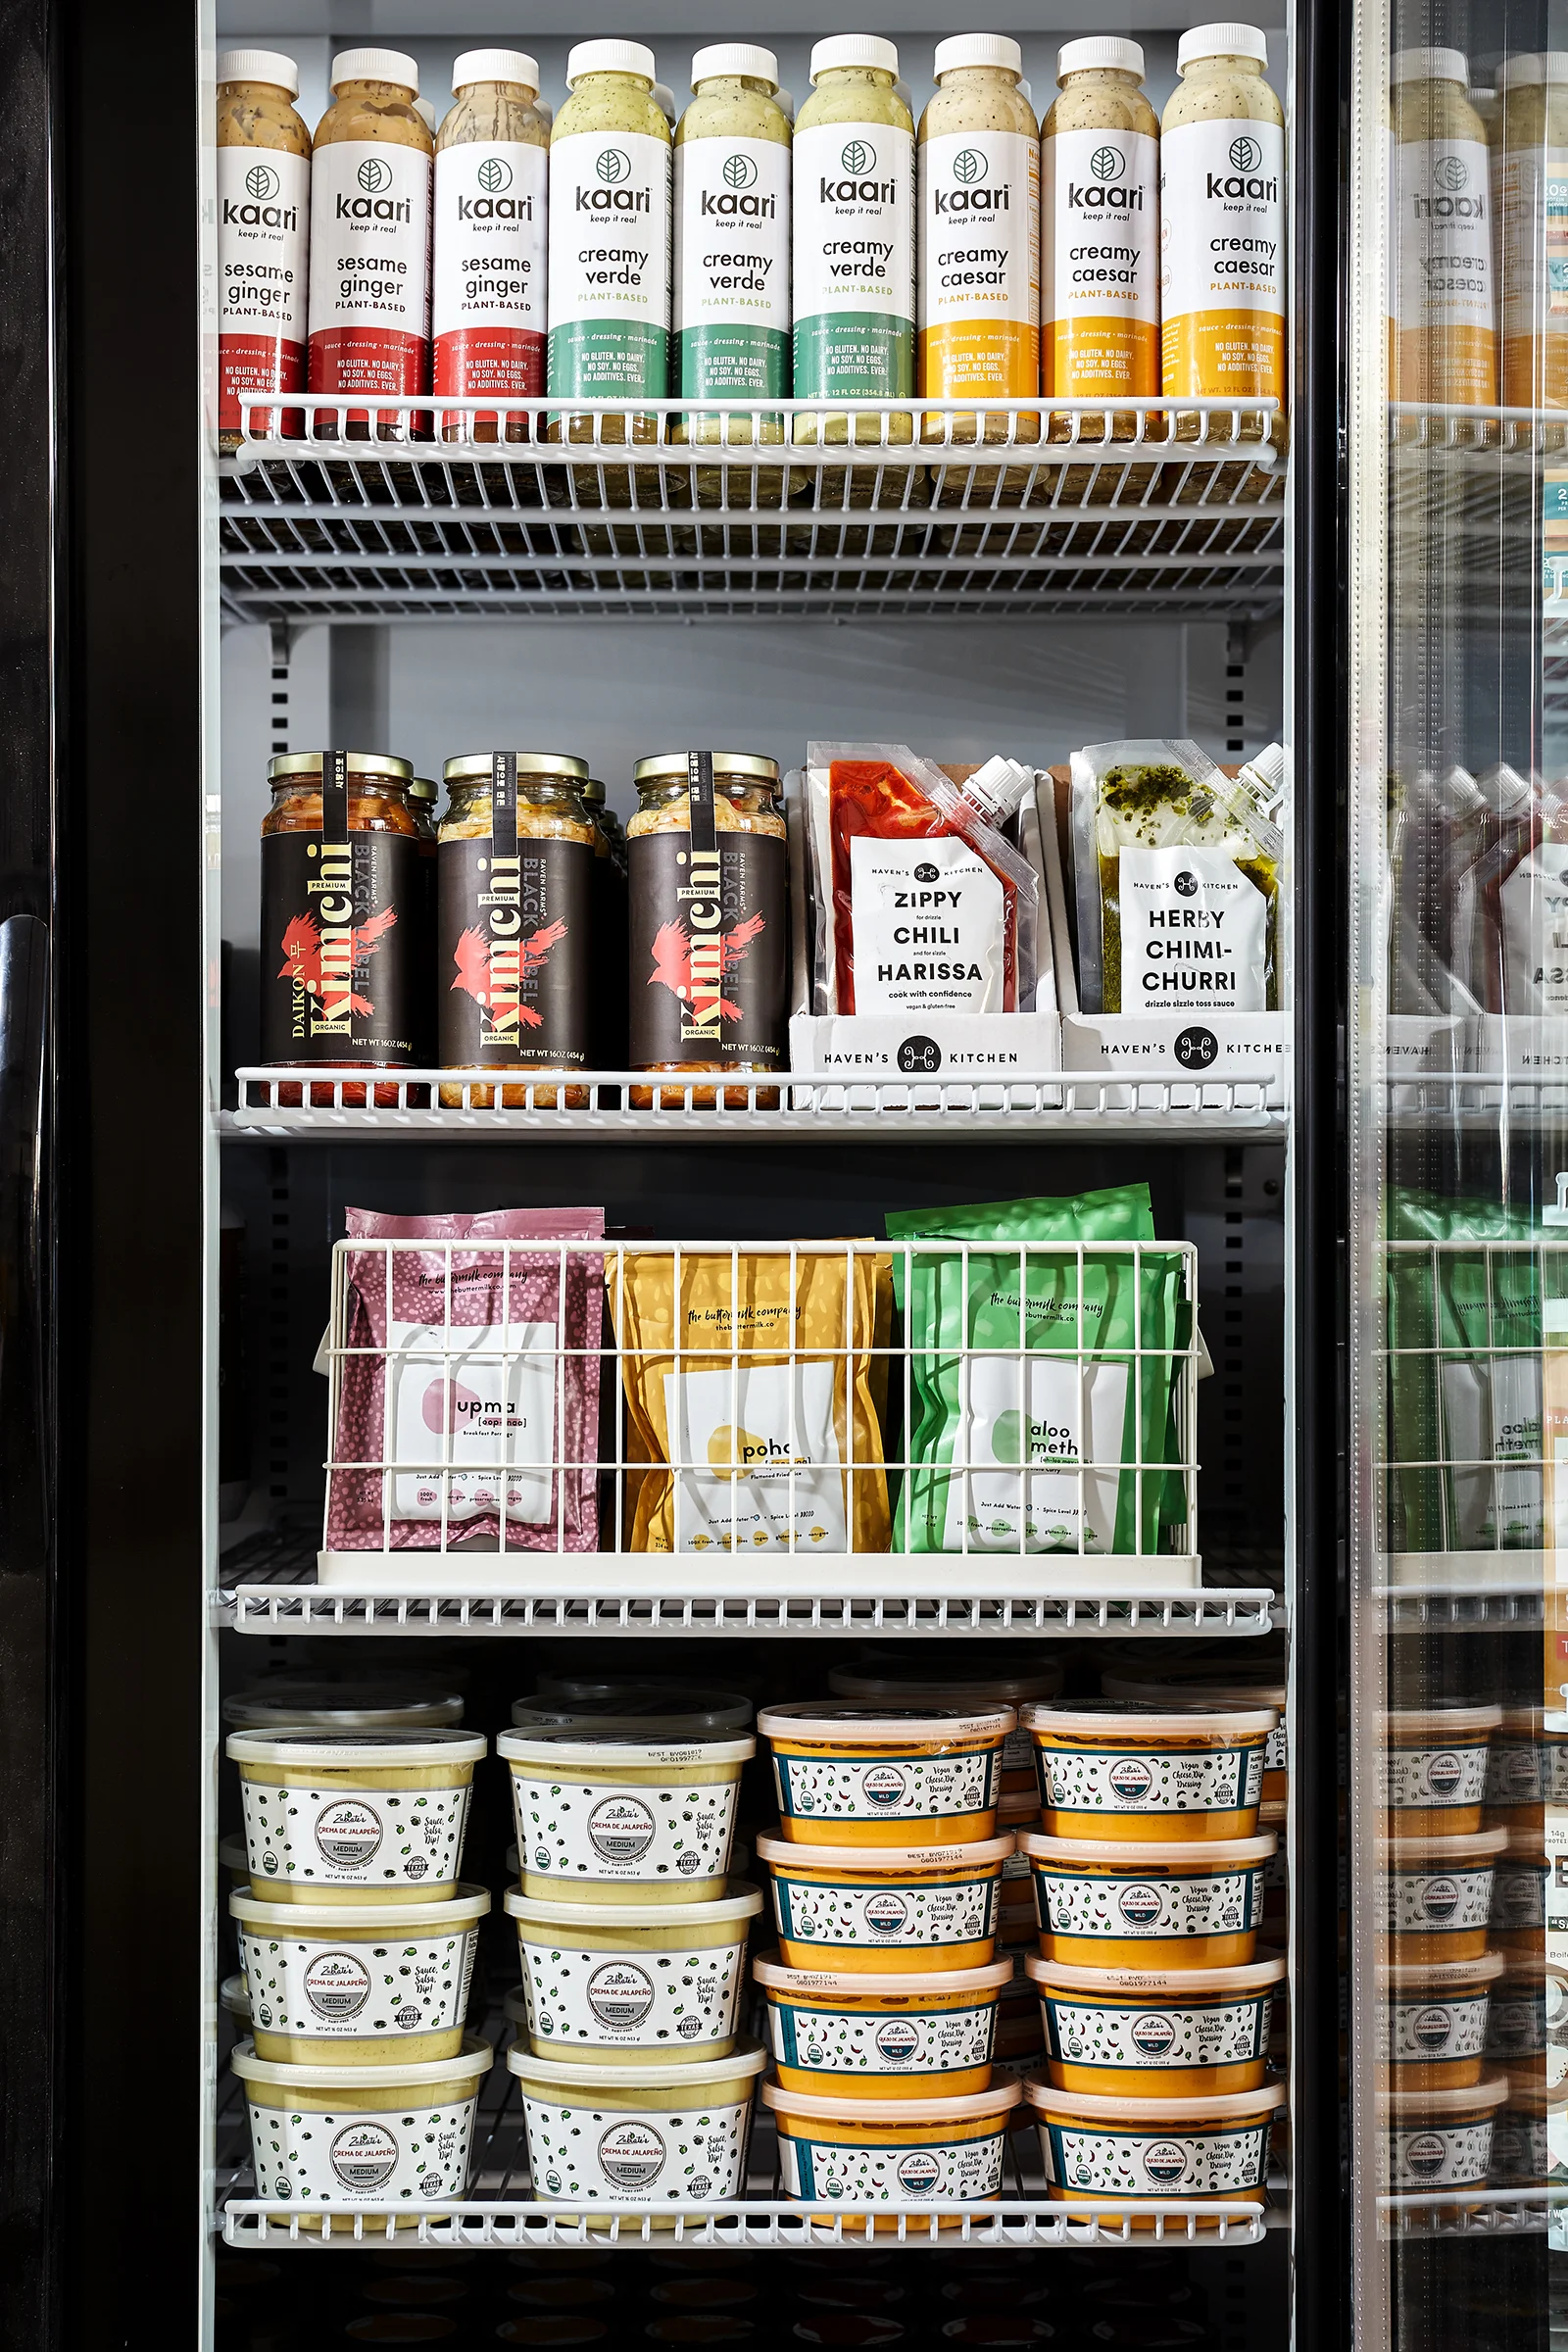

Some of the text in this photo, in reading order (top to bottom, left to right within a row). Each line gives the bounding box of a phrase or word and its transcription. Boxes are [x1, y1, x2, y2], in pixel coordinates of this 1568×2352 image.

[820, 177, 896, 204] kaari
[1068, 182, 1144, 211] kaari
[1206, 172, 1277, 203] kaari
[459, 195, 532, 221] kaari
[575, 185, 651, 213] kaari
[701, 190, 775, 219] kaari
[935, 183, 1010, 215] kaari
[223, 199, 297, 231] kaari
[336, 194, 411, 223] kaari
[350, 222, 397, 233] keep it real
[590, 215, 637, 224] keep it real
[822, 241, 894, 262] creamy
[1069, 244, 1141, 267] creamy
[1210, 236, 1276, 259] creamy
[337, 257, 407, 274] sesame
[462, 257, 531, 272] sesame
[578, 248, 649, 270] creamy
[703, 254, 773, 274] creamy
[938, 247, 1008, 267] creamy
[1213, 256, 1275, 276] caesar
[224, 264, 293, 282] sesame
[586, 265, 641, 285] verde
[830, 257, 886, 277] verde
[1072, 265, 1138, 283] caesar
[340, 273, 403, 299] ginger
[466, 274, 528, 299] ginger
[710, 270, 764, 291] verde
[941, 268, 1006, 287] caesar
[228, 281, 290, 305] ginger
[822, 284, 893, 295] PLANT-BASED
[1068, 291, 1139, 301] PLANT-BASED
[1210, 282, 1276, 294] PLANT-BASED
[335, 301, 406, 313] PLANT-BASED
[461, 301, 531, 311] PLANT-BASED
[578, 293, 648, 304] PLANT-BASED
[702, 298, 771, 309] PLANT-BASED
[938, 292, 1008, 306] PLANT-BASED
[222, 307, 292, 321] PLANT-BASED
[945, 867, 983, 876] KITCHEN
[895, 892, 962, 908] ZIPPY
[354, 844, 369, 991] BLACK LABEL
[723, 852, 739, 996] BLACK LABEL
[1150, 909, 1225, 929] HERBY
[307, 840, 353, 1037] Kimchi
[894, 927, 959, 944] CHILI
[477, 855, 520, 1049] Kimchi
[676, 850, 721, 1042] Kimchi
[1146, 941, 1232, 959] CHIMI-
[878, 963, 983, 981] HARISSA
[1142, 971, 1236, 991] CHURRI
[292, 964, 305, 1038] DAIKON
[824, 1052, 1017, 1063] HAVEN'S KITCHEN
[1102, 1044, 1165, 1054] HAVEN'S
[991, 1293, 1004, 1306] the
[688, 1309, 701, 1324] the
[458, 1402, 514, 1419] upma
[1031, 1421, 1070, 1438] aloo
[348, 1826, 379, 1835] JALAPEÑO
[621, 1821, 652, 1830] JALAPEÑO
[424, 1835, 440, 1845] Dip!
[1186, 1904, 1210, 1913] Dressing
[307, 1978, 325, 1986] CREMA
[336, 1979, 368, 1987] JALAPEÑO
[1200, 2034, 1222, 2042] Dressing
